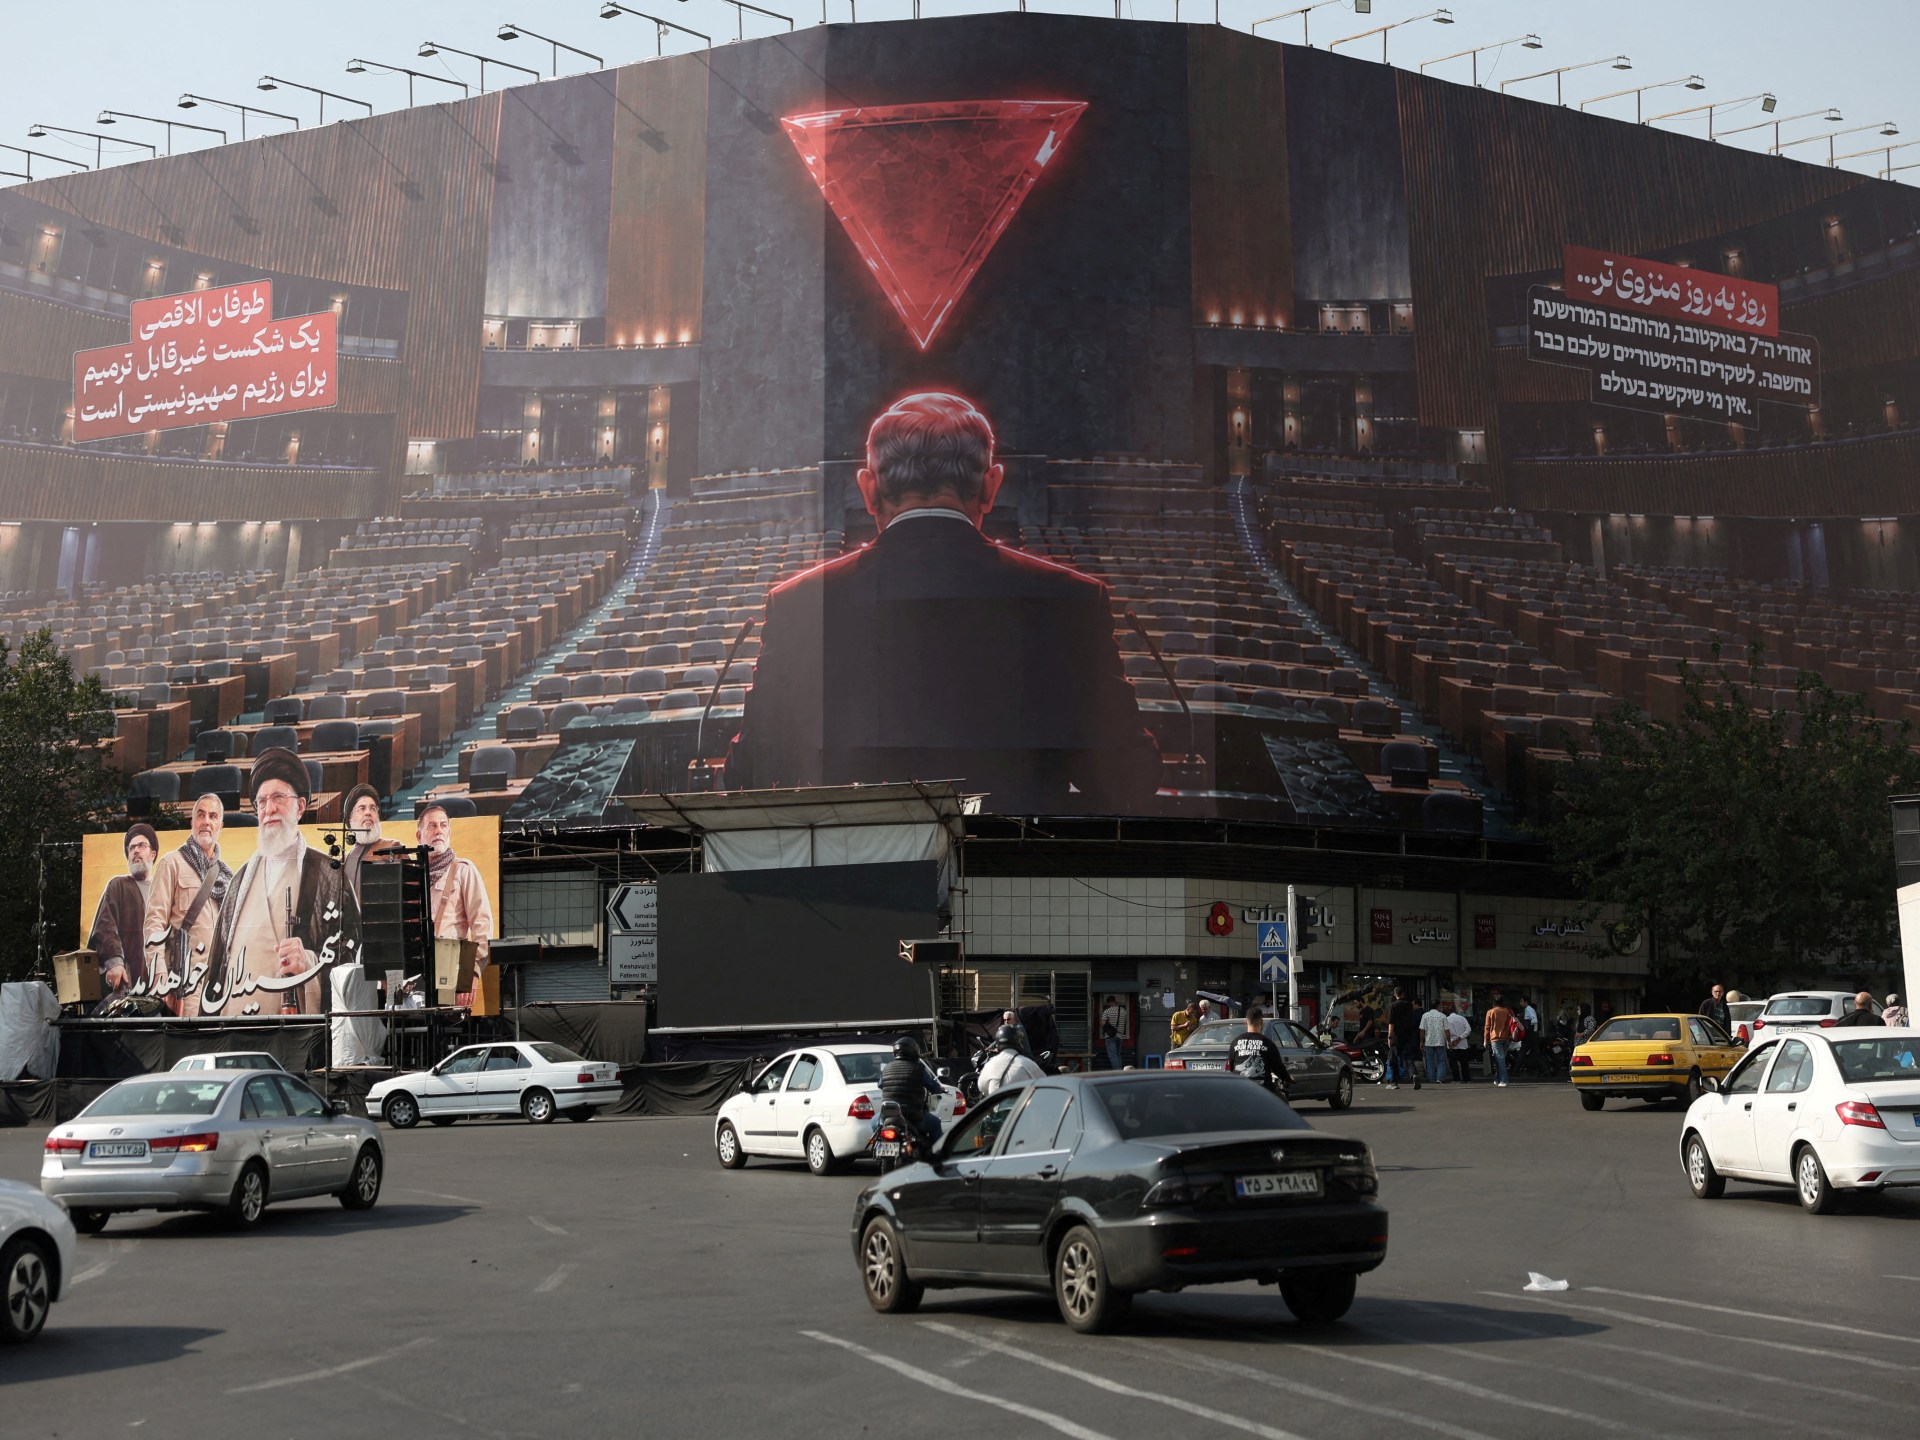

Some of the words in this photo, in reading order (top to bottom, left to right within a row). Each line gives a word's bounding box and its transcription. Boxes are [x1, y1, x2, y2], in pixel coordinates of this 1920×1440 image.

[1615, 267, 1680, 306] منزوی
[1680, 279, 1712, 316] روز
[207, 288, 265, 327] طوفان
[1533, 298, 1606, 328] המרושעת
[1714, 285, 1736, 320] به
[1735, 290, 1767, 327] روز
[139, 297, 202, 341] الاقصی
[1610, 312, 1670, 342] מהותכם
[212, 327, 285, 362] شکست
[288, 319, 321, 352] یک
[1534, 330, 1564, 351] כבר
[1567, 333, 1610, 359] שלכם
[1672, 324, 1746, 355] באוקטובר,
[1613, 344, 1698, 375] ההיסטוריים
[1777, 344, 1812, 365] אחרי
[83, 352, 133, 394] ترمیم
[289, 362, 327, 397] برای
[1600, 369, 1647, 398] בעולם
[1700, 360, 1756, 385] לשקרים
[1758, 371, 1811, 395] נחשפה.
[80, 390, 123, 422] است
[127, 384, 238, 424] صهیونیستی
[241, 371, 285, 411] رژیم
[1649, 380, 1704, 408] שיקשיב
[1706, 390, 1723, 407] מי
[634, 888, 657, 897] الزاده
[1244, 903, 1288, 924] ملت
[1411, 927, 1451, 944] ساعتی
